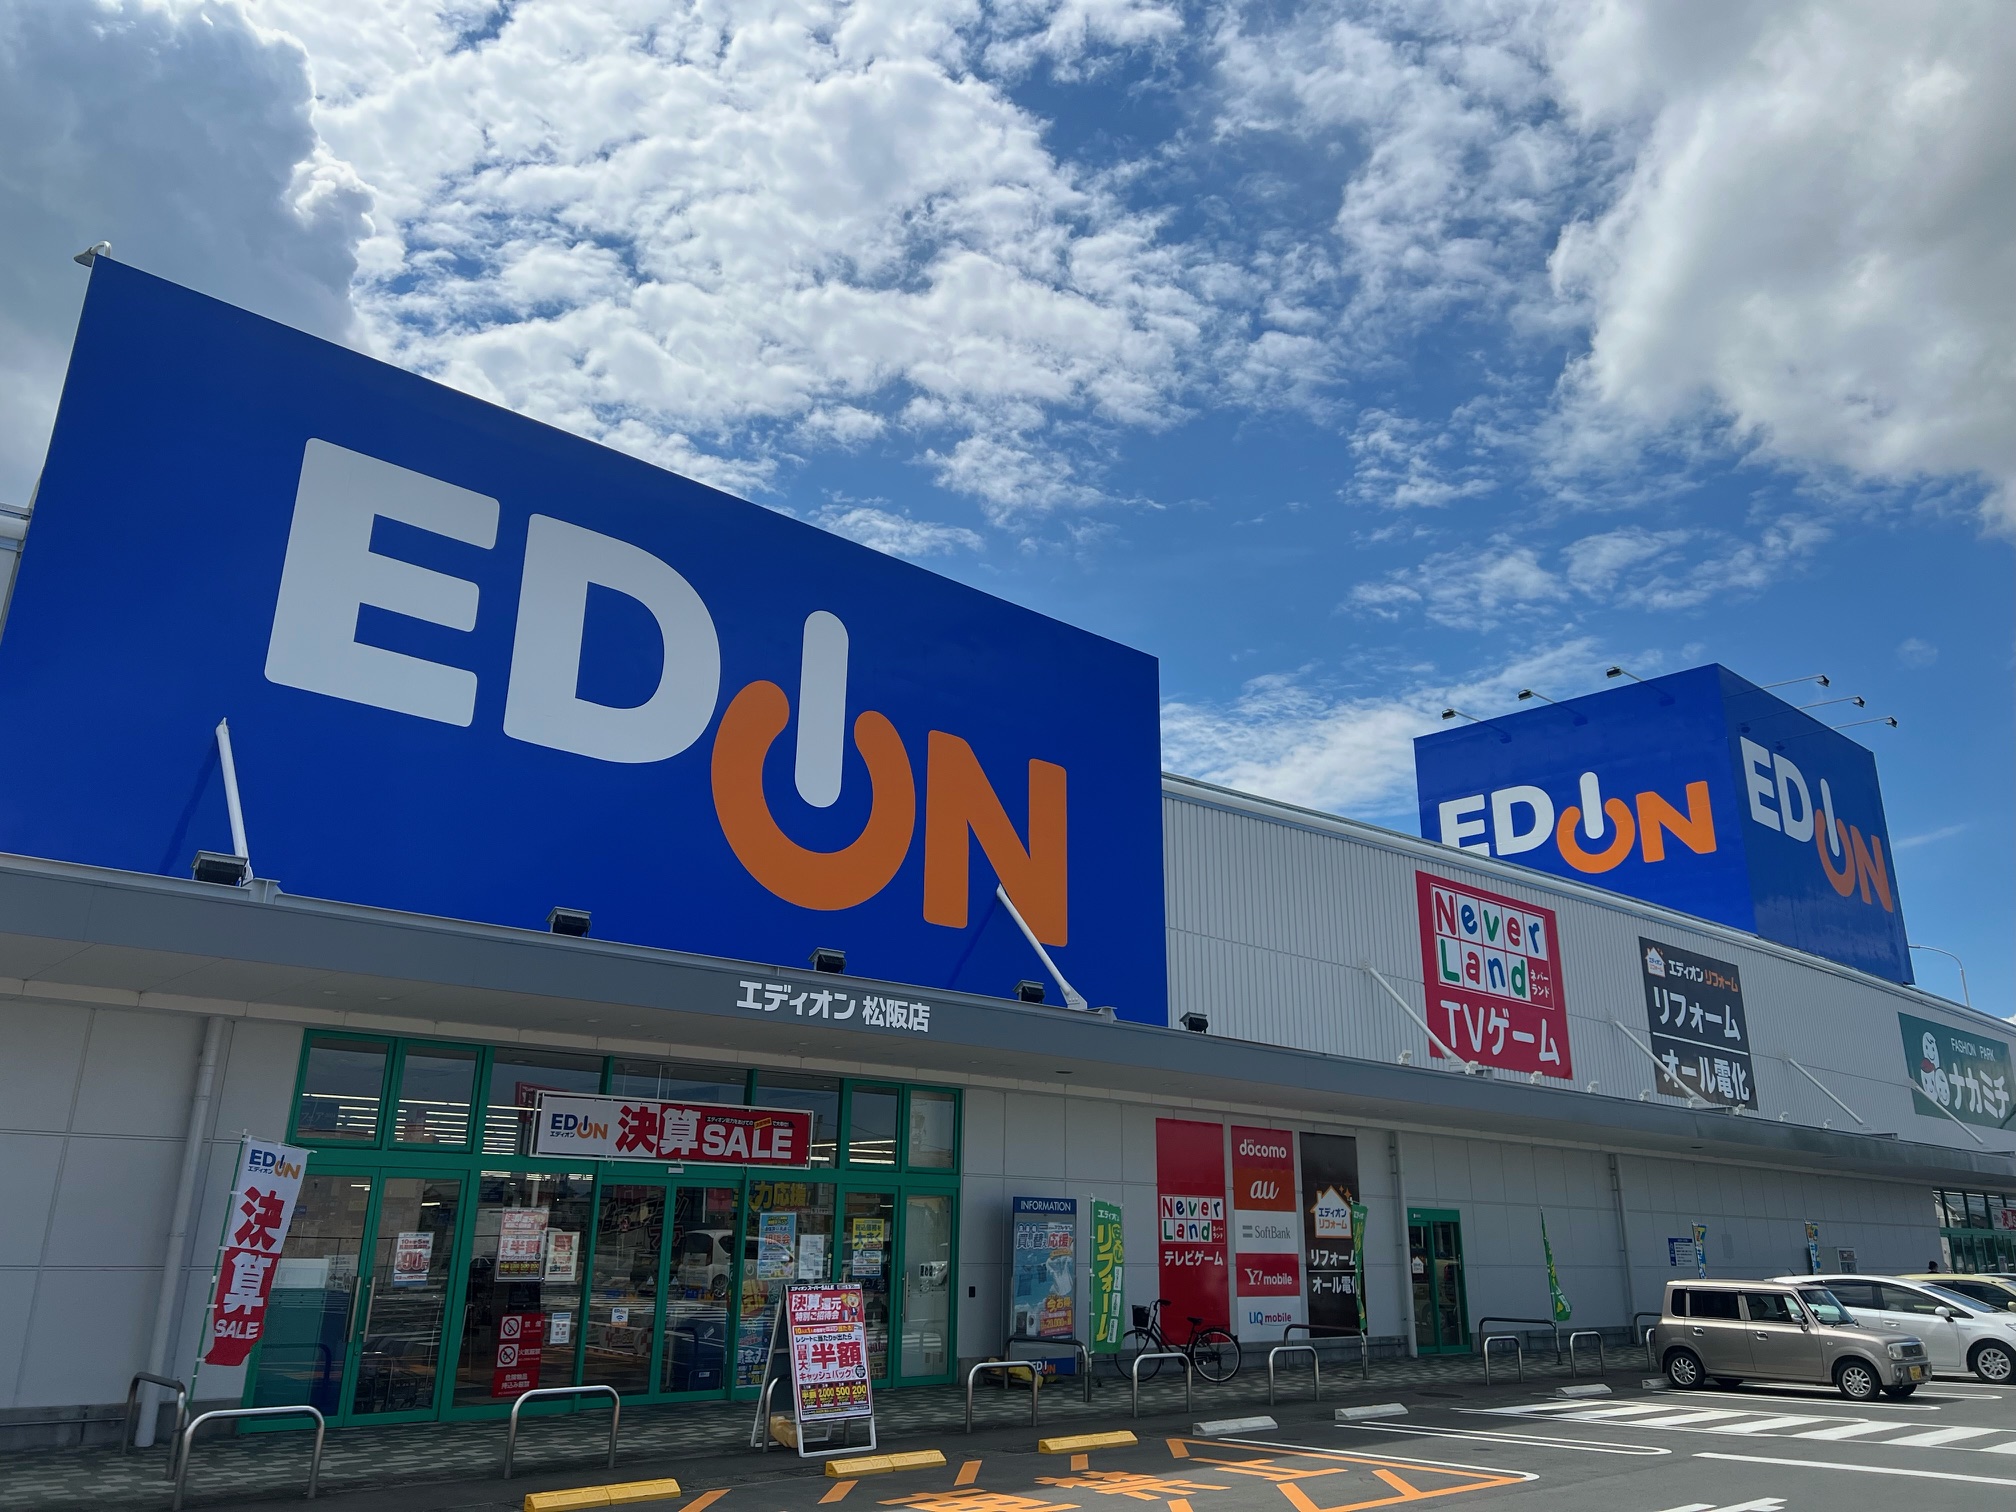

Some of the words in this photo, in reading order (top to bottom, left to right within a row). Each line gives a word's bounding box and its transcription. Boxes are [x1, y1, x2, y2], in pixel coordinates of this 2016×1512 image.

[264, 437, 1068, 947] EDION
[1438, 771, 1718, 874] EDION
[1740, 735, 1894, 913] EDION
[1435, 891, 1540, 954] Never
[1440, 938, 1526, 999] Land
[1530, 969, 1549, 981] ネバー
[1668, 960, 1704, 983] エディオン
[1705, 969, 1739, 992] リフォーム
[1531, 983, 1550, 999] ランド
[736, 980, 856, 1020] エディオン
[862, 995, 931, 1033] 松阪店
[1653, 986, 1742, 1041] リフォーム
[1440, 1000, 1560, 1066] TVゲーム
[1950, 1038, 1977, 1057] FASHION
[1979, 1045, 1996, 1062] PARK
[1661, 1049, 1750, 1101] オール電化
[1948, 1062, 2010, 1119] ナカミチ
[551, 1113, 608, 1140] EDION
[1239, 1139, 1287, 1159] docomo
[249, 1148, 301, 1180] EDION
[1250, 1180, 1280, 1200] au
[1020, 1200, 1072, 1212] INFORMATION
[1162, 1197, 1221, 1218] Never
[1318, 1207, 1347, 1218] エディオン
[1163, 1220, 1211, 1242] Land
[1254, 1225, 1291, 1240] SoftBank
[1318, 1219, 1348, 1230] リフォーム
[223, 1186, 286, 1315] 決算
[1164, 1250, 1224, 1267] テレビゲーム
[214, 1318, 260, 1340] SALE
[1264, 1312, 1292, 1324] mobile
[811, 1341, 863, 1370] 半額
